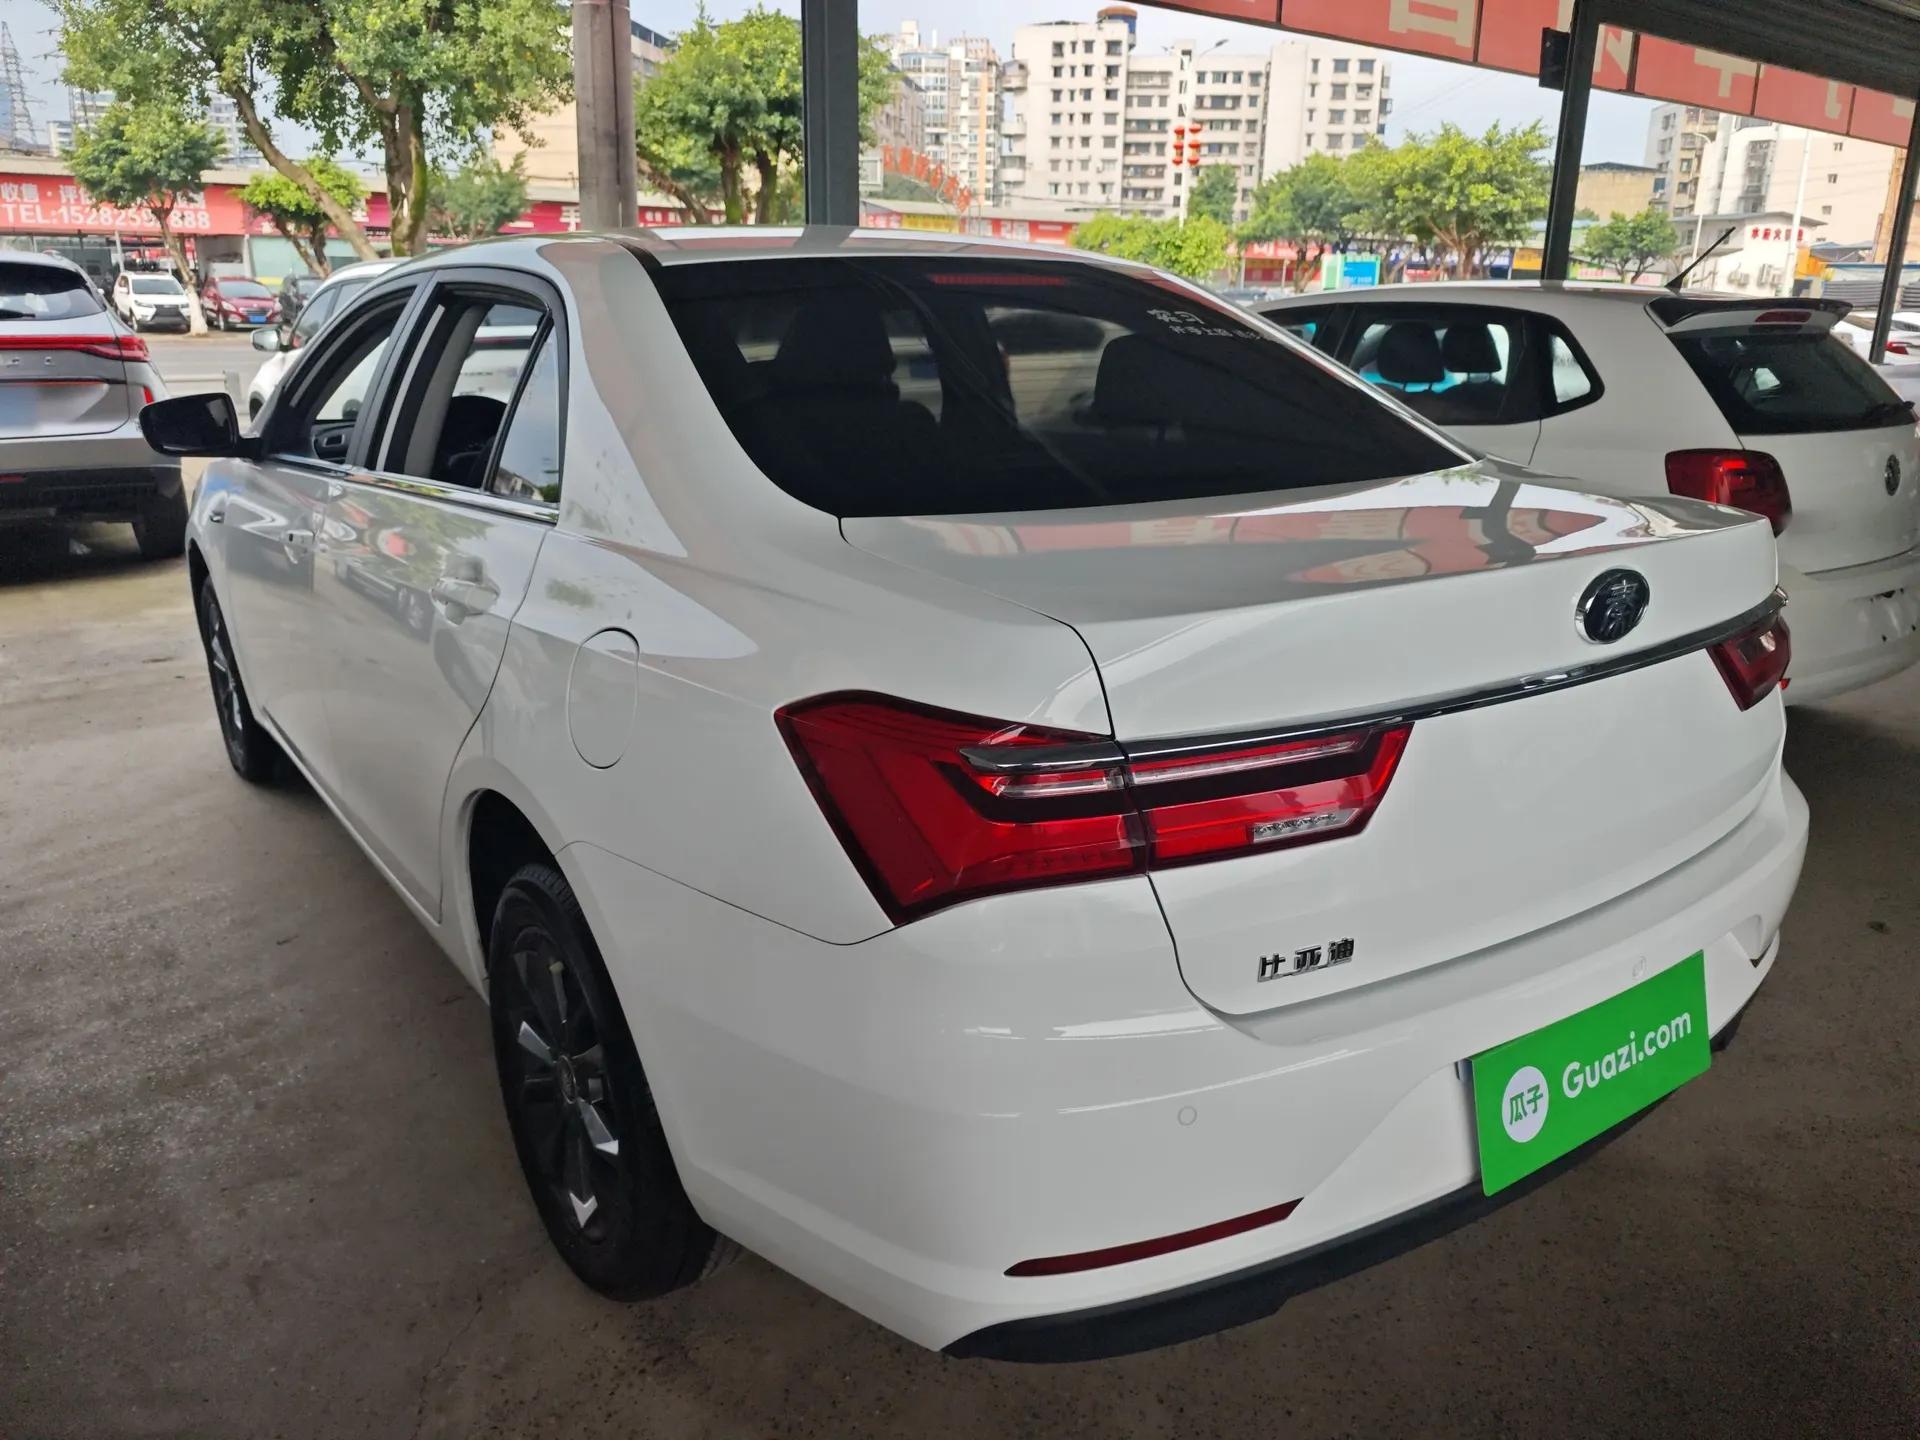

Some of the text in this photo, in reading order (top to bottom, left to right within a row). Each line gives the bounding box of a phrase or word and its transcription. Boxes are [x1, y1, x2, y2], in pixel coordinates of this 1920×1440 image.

[0, 203, 211, 229] TEL:1528259888
[1257, 938, 1355, 983] 比亚迪
[1562, 1012, 1692, 1099] Guazi.com
[1509, 1084, 1544, 1126] 瓜子
